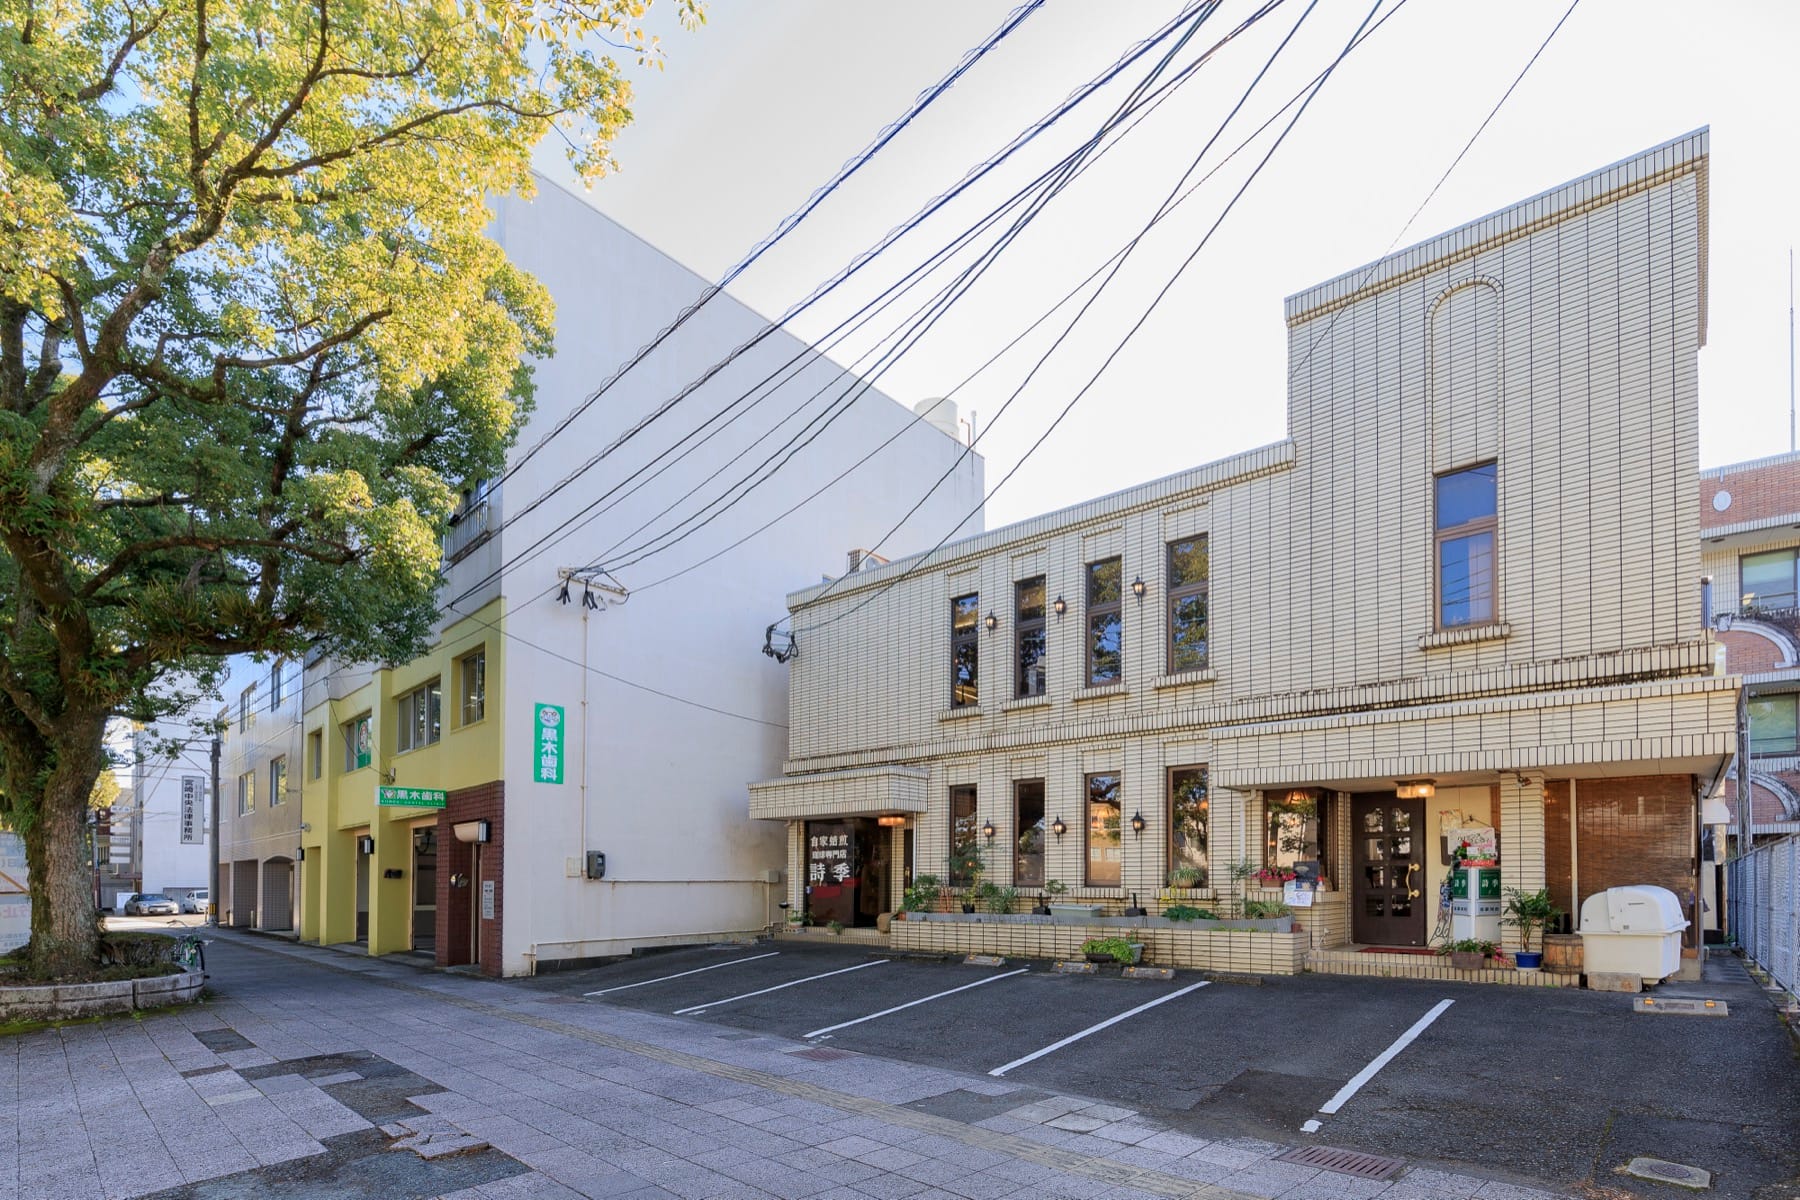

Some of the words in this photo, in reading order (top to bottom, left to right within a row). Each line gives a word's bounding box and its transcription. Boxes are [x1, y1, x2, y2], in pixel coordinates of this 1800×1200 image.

[541, 727, 557, 780] 黒木歯科
[397, 789, 444, 801] 黒木歯科
[184, 779, 194, 841] 宮崎中央法律事務所
[811, 835, 848, 847] 自家焙煎
[810, 862, 850, 887] 詩季
